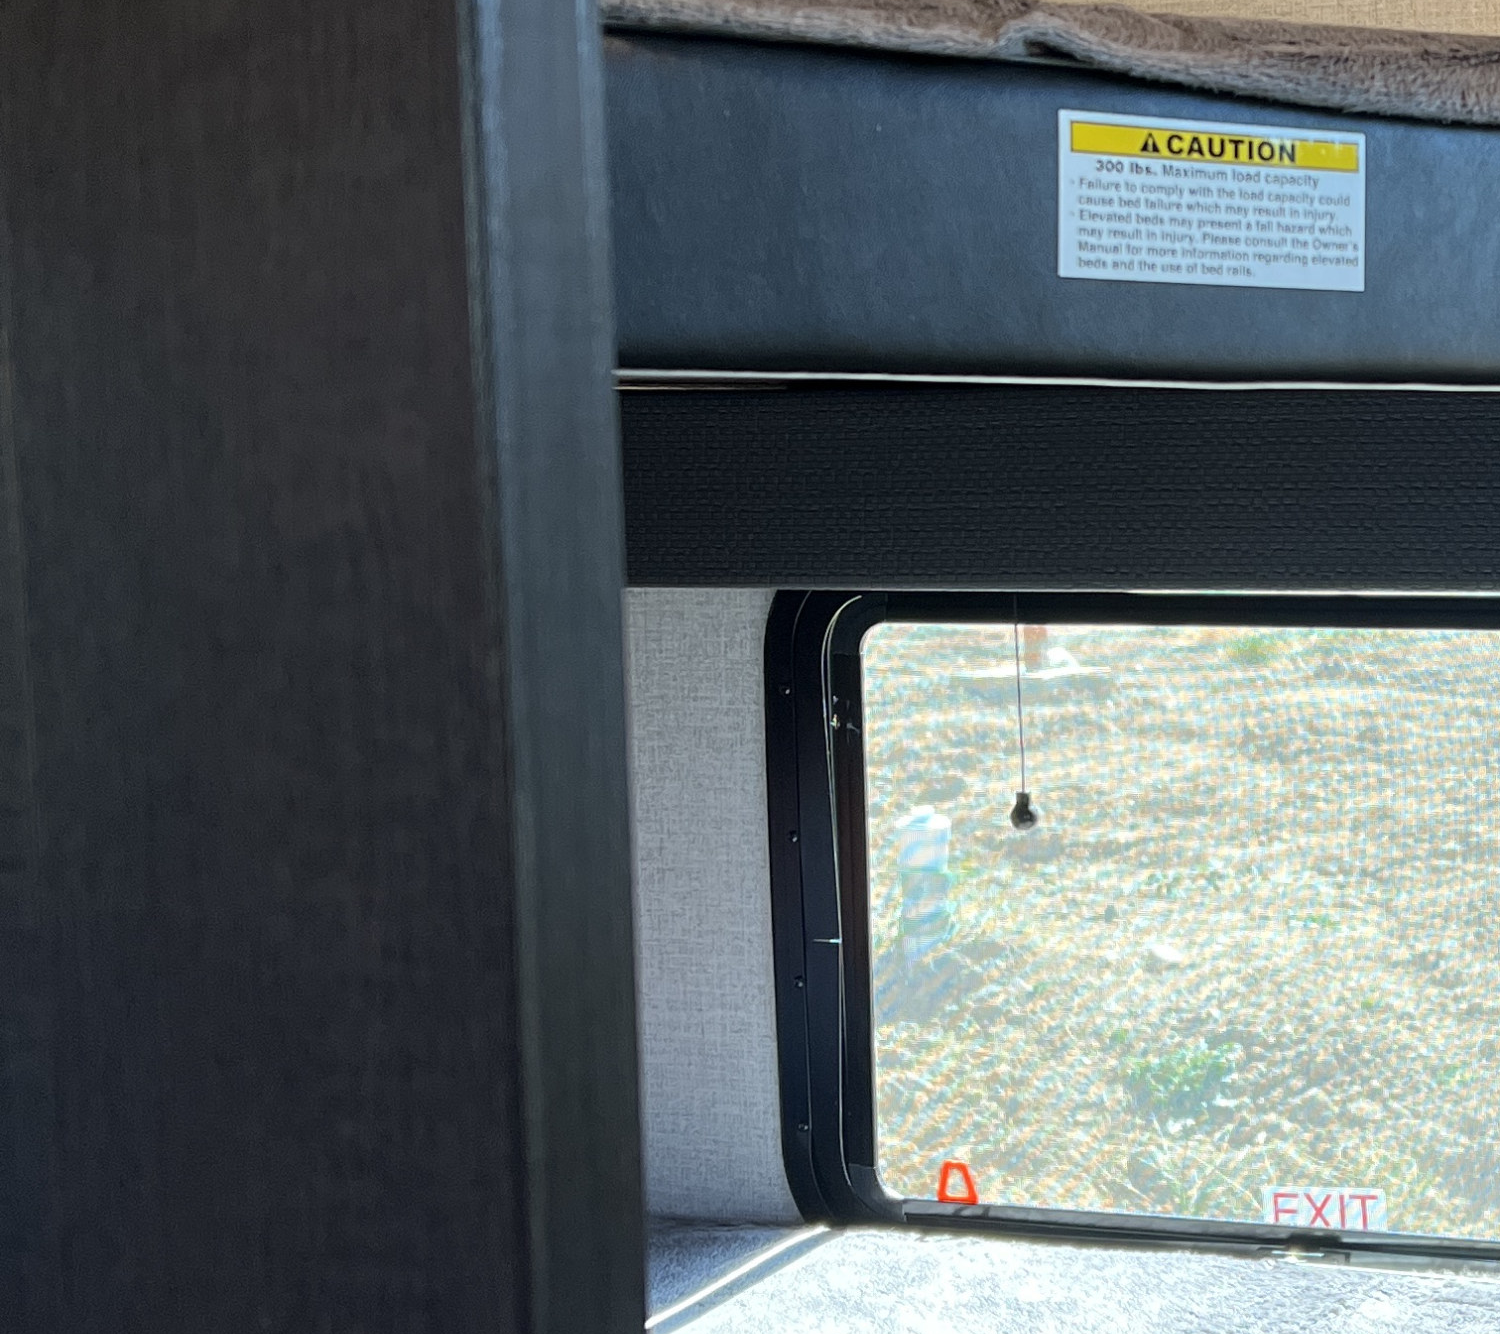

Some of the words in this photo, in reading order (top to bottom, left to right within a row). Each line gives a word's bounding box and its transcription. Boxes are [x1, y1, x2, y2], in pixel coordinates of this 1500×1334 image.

[1166, 135, 1296, 163] CAUTION
[1096, 160, 1124, 173] 300
[1129, 162, 1158, 176] lbs.
[1162, 164, 1228, 181] Maximum
[1232, 169, 1261, 183] load
[1264, 173, 1320, 190] capacity
[1079, 178, 1121, 192] Failure
[1125, 180, 1137, 193] to
[1141, 182, 1185, 198] comply
[1188, 186, 1213, 198] with
[1217, 188, 1236, 199] the
[1239, 189, 1264, 202] load
[1268, 192, 1315, 207] capacity
[1319, 195, 1350, 207] could
[1078, 196, 1113, 207] cause
[1119, 197, 1141, 209] bed
[1145, 198, 1182, 212] failure
[1186, 201, 1222, 213] which
[1225, 206, 1250, 218] may
[1253, 206, 1286, 218] result
[1290, 208, 1300, 219] in
[1079, 209, 1132, 224] Elevated
[1135, 213, 1165, 226] beds
[1169, 216, 1193, 230] may
[1197, 219, 1242, 232] present
[1246, 223, 1253, 232] a
[1256, 220, 1274, 233] fall
[1277, 221, 1315, 235] hazard
[1318, 224, 1353, 237] which
[1078, 227, 1103, 239] may
[1108, 228, 1143, 241] result
[1147, 230, 1158, 241] in
[1202, 232, 1242, 245] Please
[1245, 235, 1288, 248] consult
[1291, 238, 1309, 250] the
[1077, 257, 1108, 269] beds
[1112, 259, 1135, 271] and
[1138, 259, 1158, 272] the
[1161, 263, 1183, 274] use
[1186, 262, 1198, 274] of
[1201, 263, 1224, 276] bed
[1078, 241, 1123, 254] Manual
[1126, 242, 1142, 255] for
[1147, 246, 1178, 257] more
[1181, 245, 1250, 262] information
[1253, 252, 1308, 267] regarding
[1311, 255, 1359, 267] elevated
[1272, 1192, 1379, 1231] EXIT
